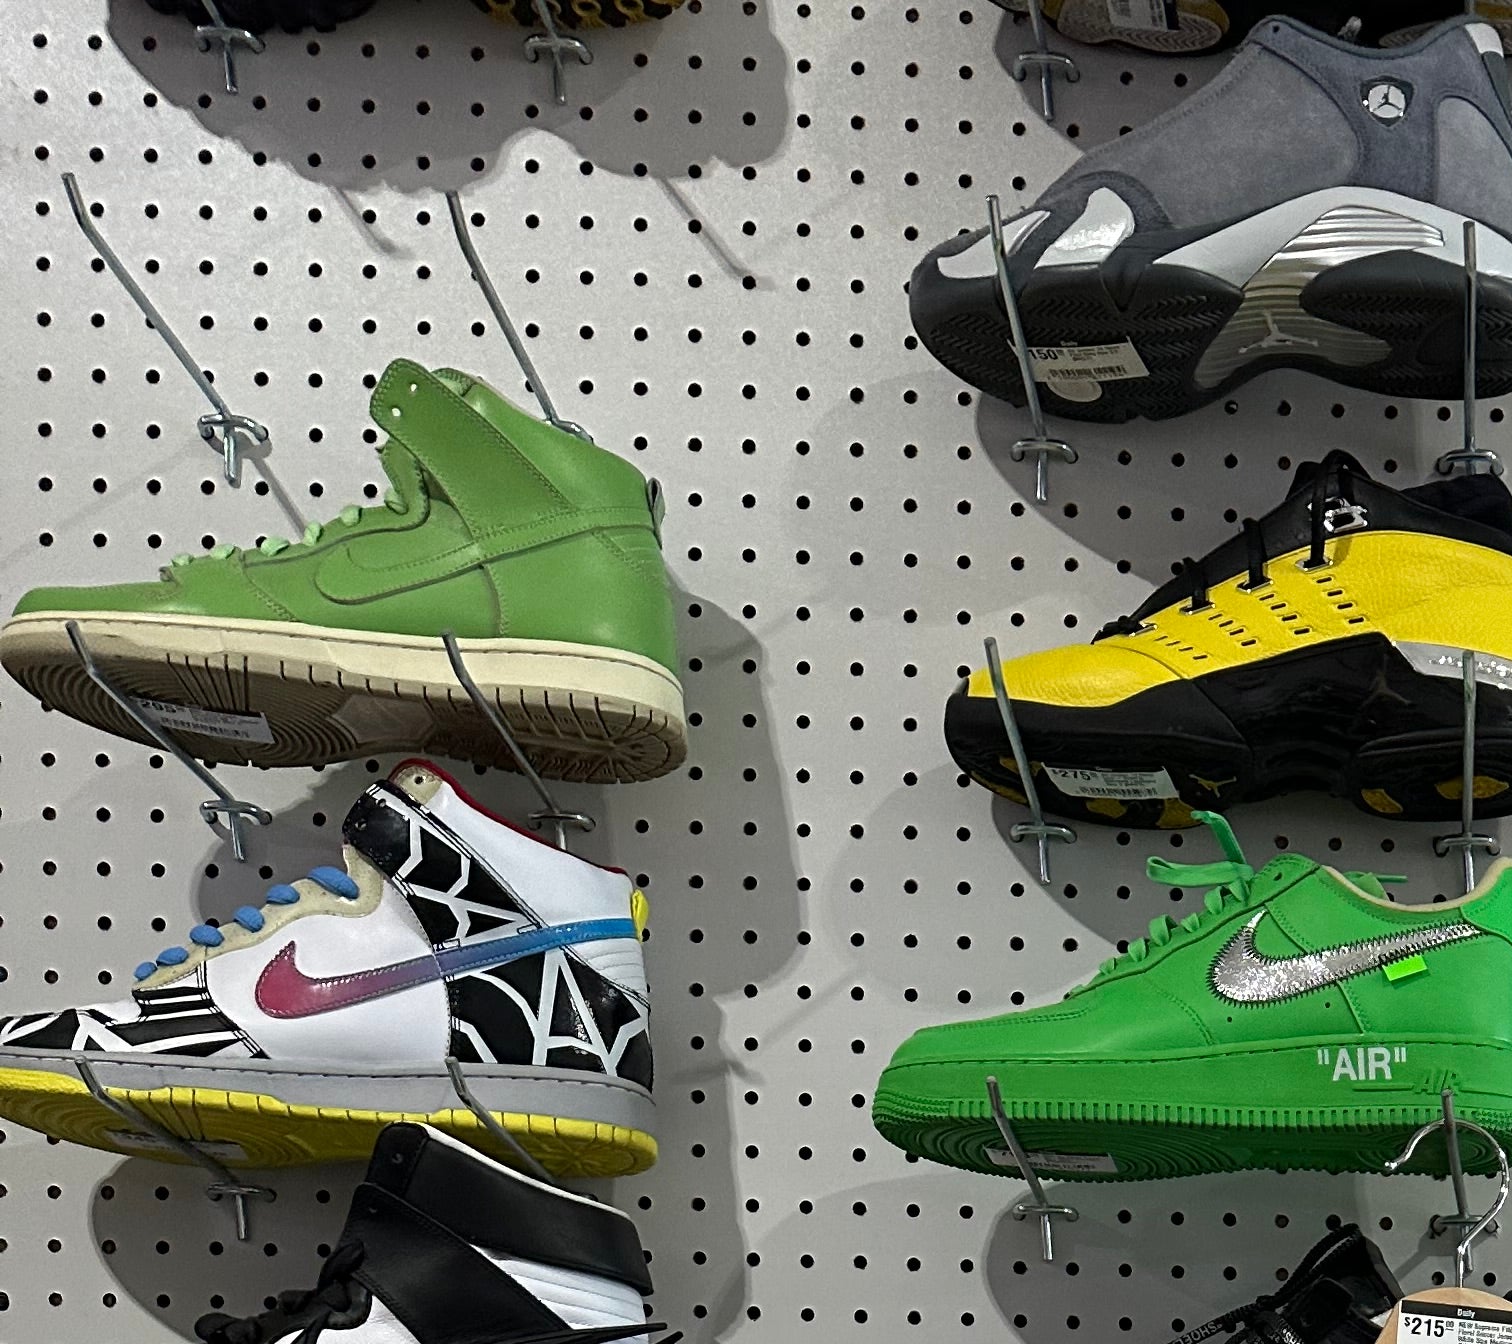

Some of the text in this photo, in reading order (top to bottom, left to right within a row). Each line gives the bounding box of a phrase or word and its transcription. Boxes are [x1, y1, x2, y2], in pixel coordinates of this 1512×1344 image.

[1026, 348, 1059, 360] 150
[1317, 1047, 1407, 1081] "AIR"
[1404, 1316, 1445, 1337] $215
